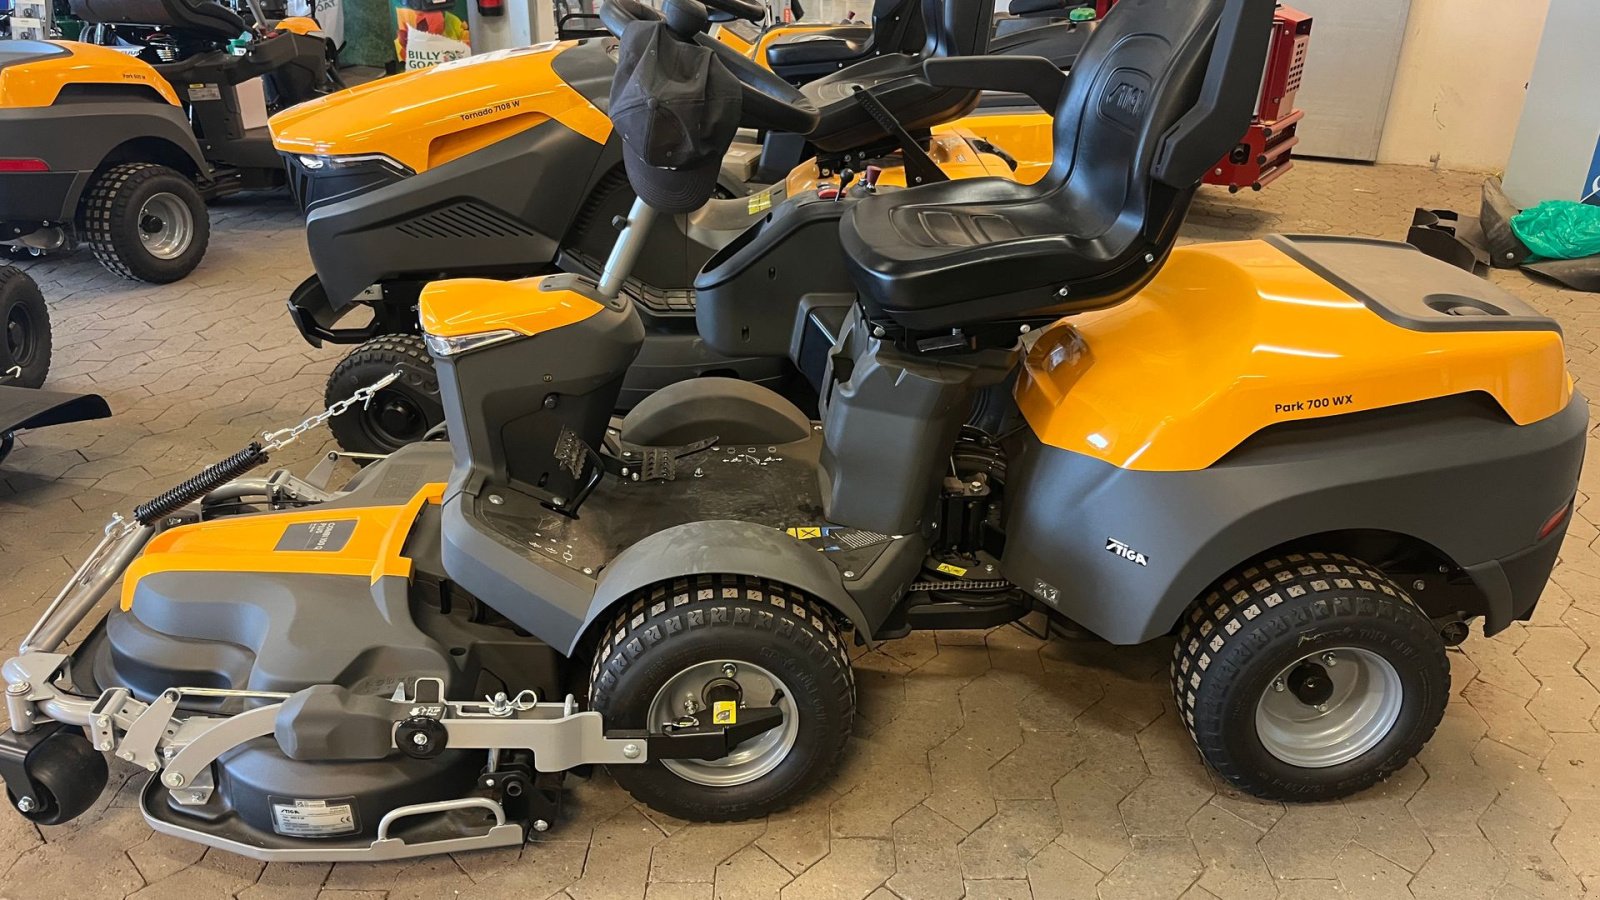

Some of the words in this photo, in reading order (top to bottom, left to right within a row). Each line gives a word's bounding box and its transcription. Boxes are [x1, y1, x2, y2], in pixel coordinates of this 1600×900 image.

[408, 50, 440, 60] BILLY
[461, 108, 493, 120] Tornado
[494, 102, 511, 112] 7108
[1275, 401, 1304, 413] Park
[1306, 398, 1330, 409] 700
[1332, 394, 1353, 406] WX
[1106, 537, 1147, 566] STIGA
